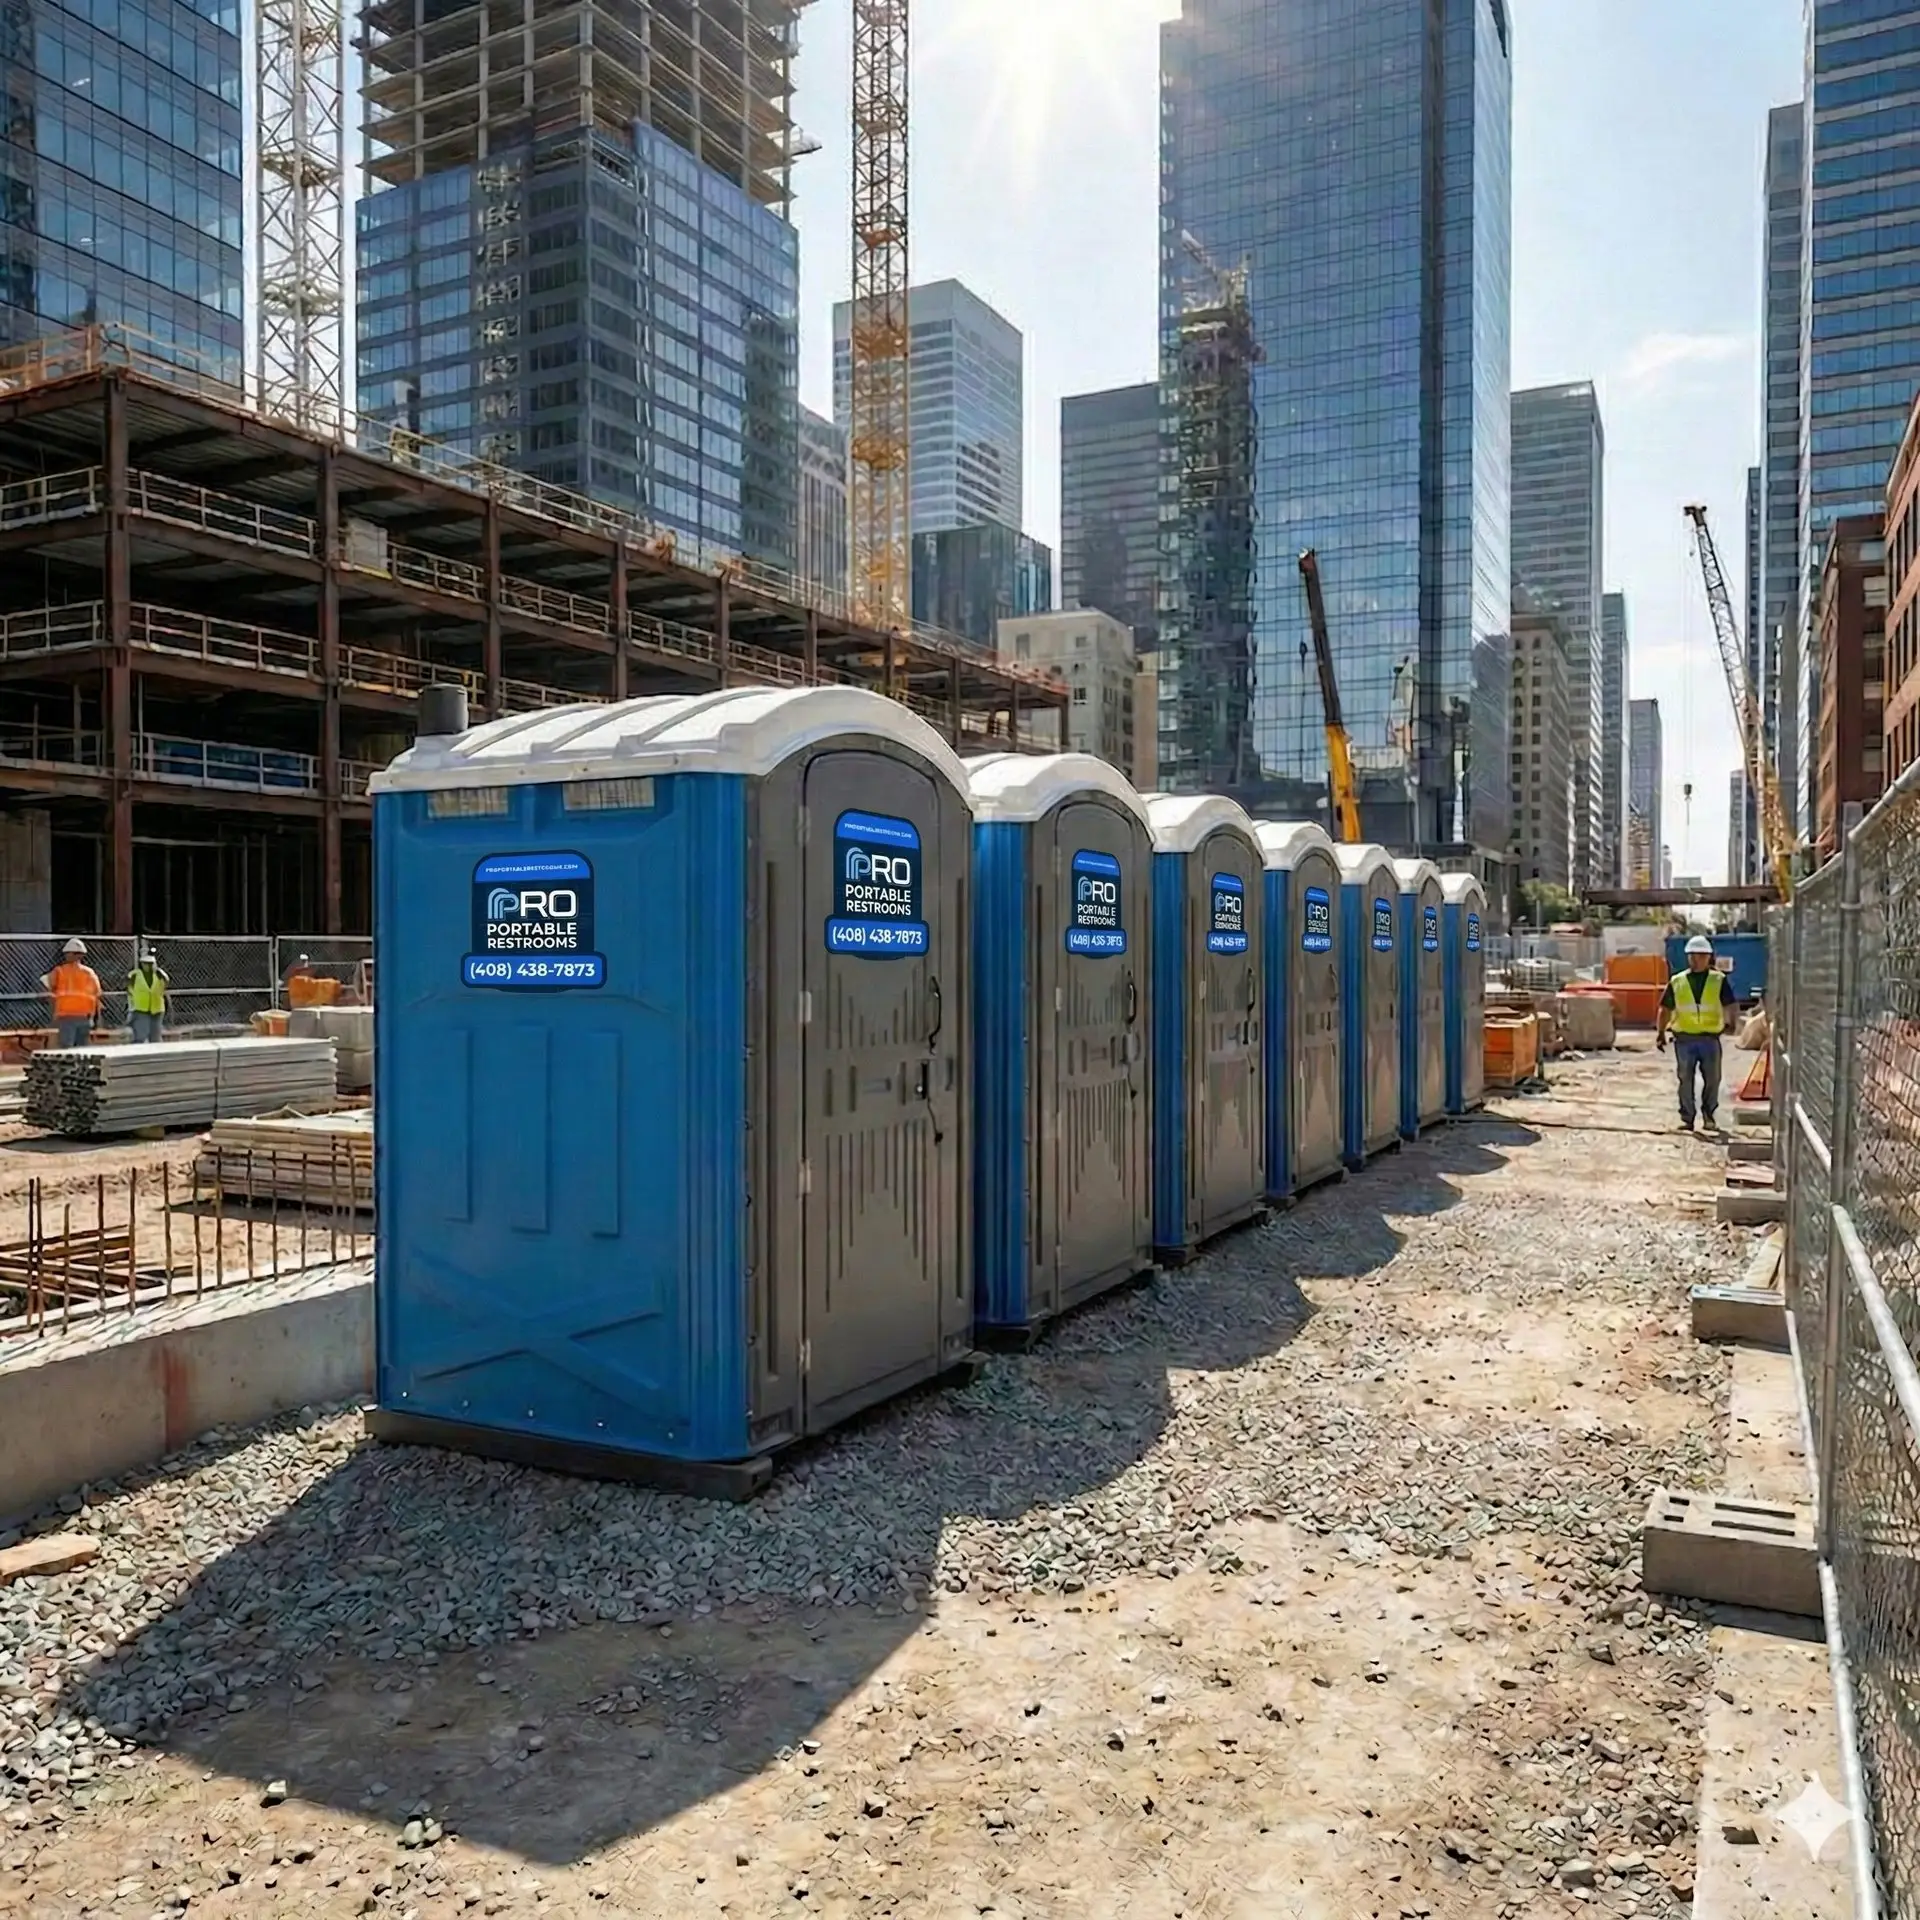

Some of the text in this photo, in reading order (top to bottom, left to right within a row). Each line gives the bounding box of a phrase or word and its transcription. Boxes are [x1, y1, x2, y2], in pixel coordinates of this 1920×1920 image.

[845, 846, 911, 885] PRO
[845, 884, 911, 902] PORTABLE
[1077, 875, 1116, 903] PRO
[487, 887, 577, 919] PRO
[487, 922, 577, 936] PORTABLE
[832, 926, 922, 946] (408) 438-7873
[487, 936, 577, 949] RESTROOMS
[470, 962, 595, 980] (408) 438-7873
